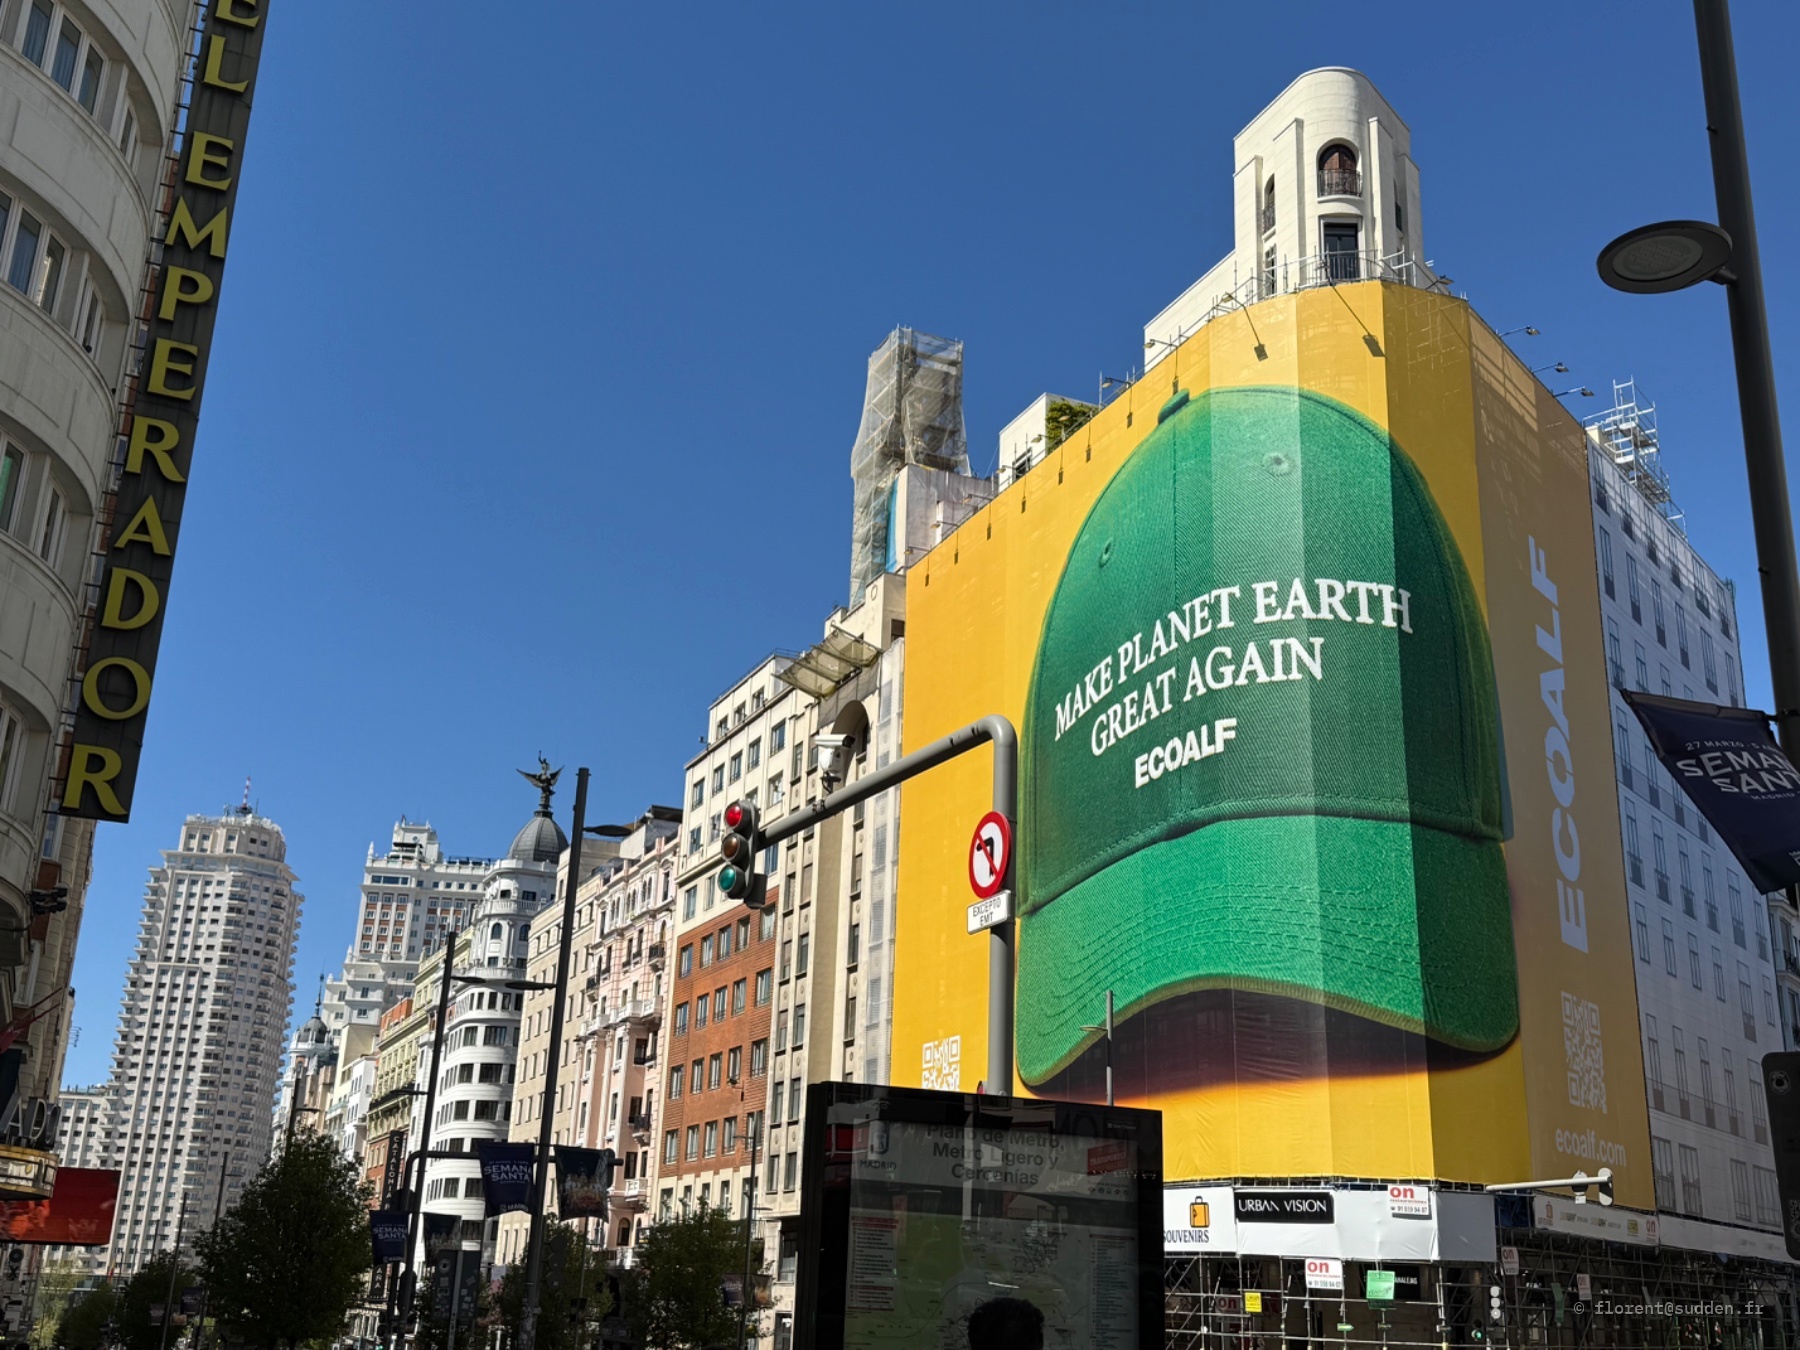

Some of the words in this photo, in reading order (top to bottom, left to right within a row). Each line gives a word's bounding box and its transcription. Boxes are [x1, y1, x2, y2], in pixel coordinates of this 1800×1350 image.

[62, 131, 228, 816] EMPERADOR
[1054, 659, 1114, 742] MAKE
[1118, 585, 1240, 682] PLANET
[1252, 578, 1414, 635] EARTH
[1091, 668, 1177, 757] GREAT
[1183, 637, 1326, 702] AGAIN
[1135, 718, 1238, 788] ECOALF
[1528, 535, 1588, 953] ECOALF
[1684, 740, 1701, 751] 27
[1704, 740, 1745, 748] MARZO
[972, 897, 1002, 917] EXCEPTO
[980, 912, 994, 927] EMT
[927, 1124, 977, 1139] Plano
[983, 1126, 1004, 1143] de
[1009, 1131, 1065, 1152] Metro,
[1555, 1127, 1627, 1168] ecoalf.com
[386, 1135, 400, 1198] CATALONIA
[860, 1160, 897, 1171] MADRID
[932, 1142, 984, 1160] Metro
[990, 1147, 1044, 1167] Ligero
[1049, 1155, 1059, 1170] y
[491, 1172, 530, 1183] SANTA
[1390, 1186, 1414, 1199] on
[1238, 1198, 1280, 1212] URBAN
[1284, 1198, 1328, 1213] VISION
[1307, 1261, 1329, 1273] on
[1218, 1297, 1237, 1309] on
